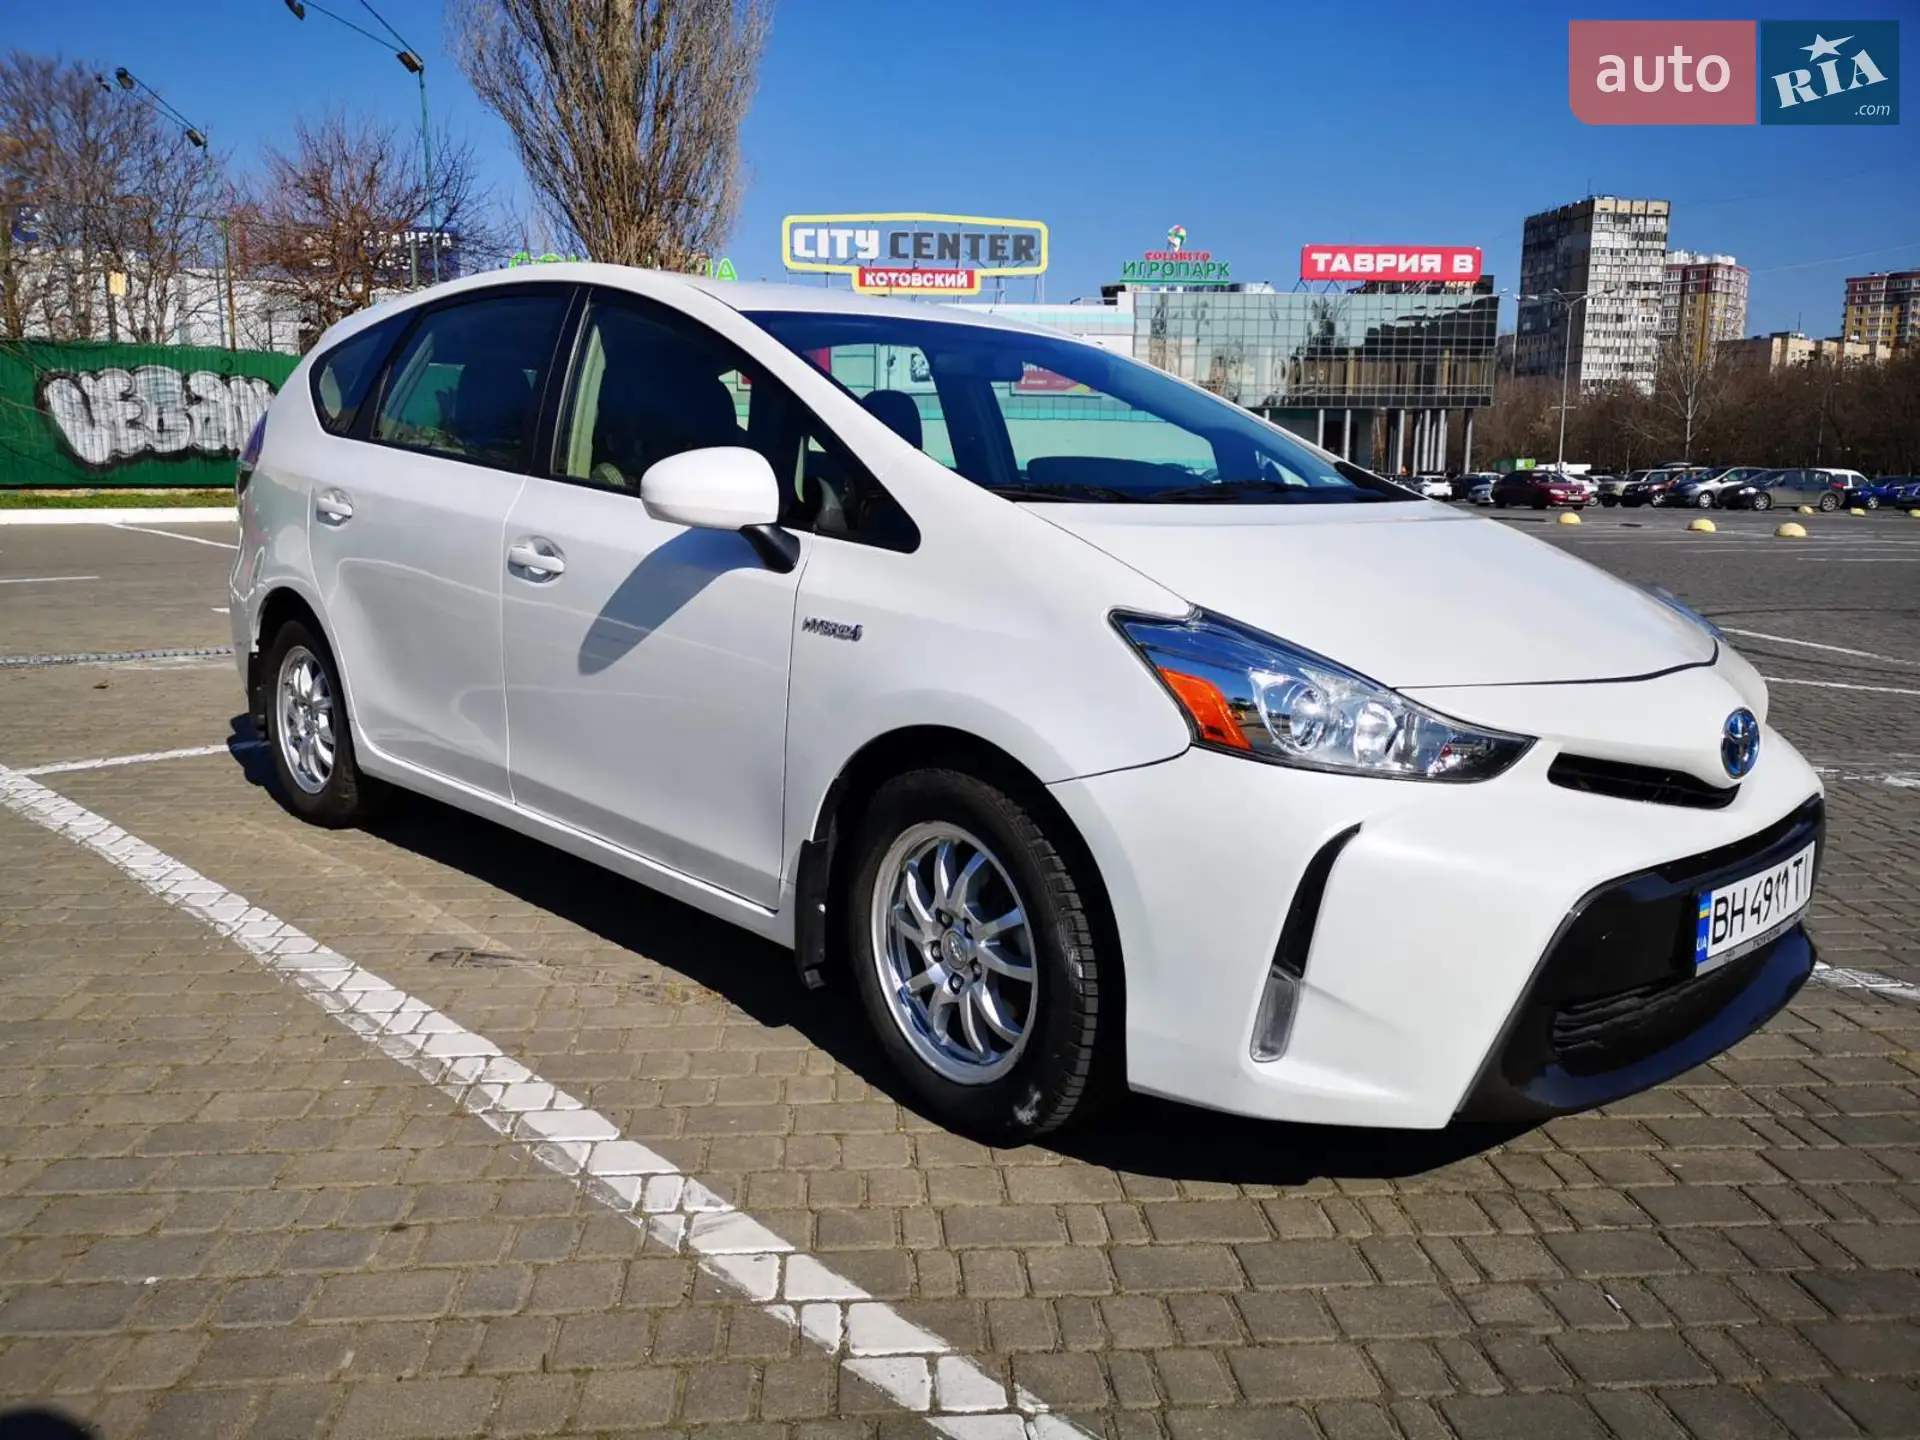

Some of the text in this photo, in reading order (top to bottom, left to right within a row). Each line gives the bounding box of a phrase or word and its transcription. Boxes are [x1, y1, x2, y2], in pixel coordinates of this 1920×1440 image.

[794, 228, 1036, 262] CITY CENTER
[1122, 260, 1230, 277] ИГРОПАРК
[1311, 253, 1474, 273] ТАВРИЯ В
[864, 270, 969, 289] КОТОВСКИЙ
[1711, 887, 1747, 946] BH
[1750, 866, 1789, 925] 4911
